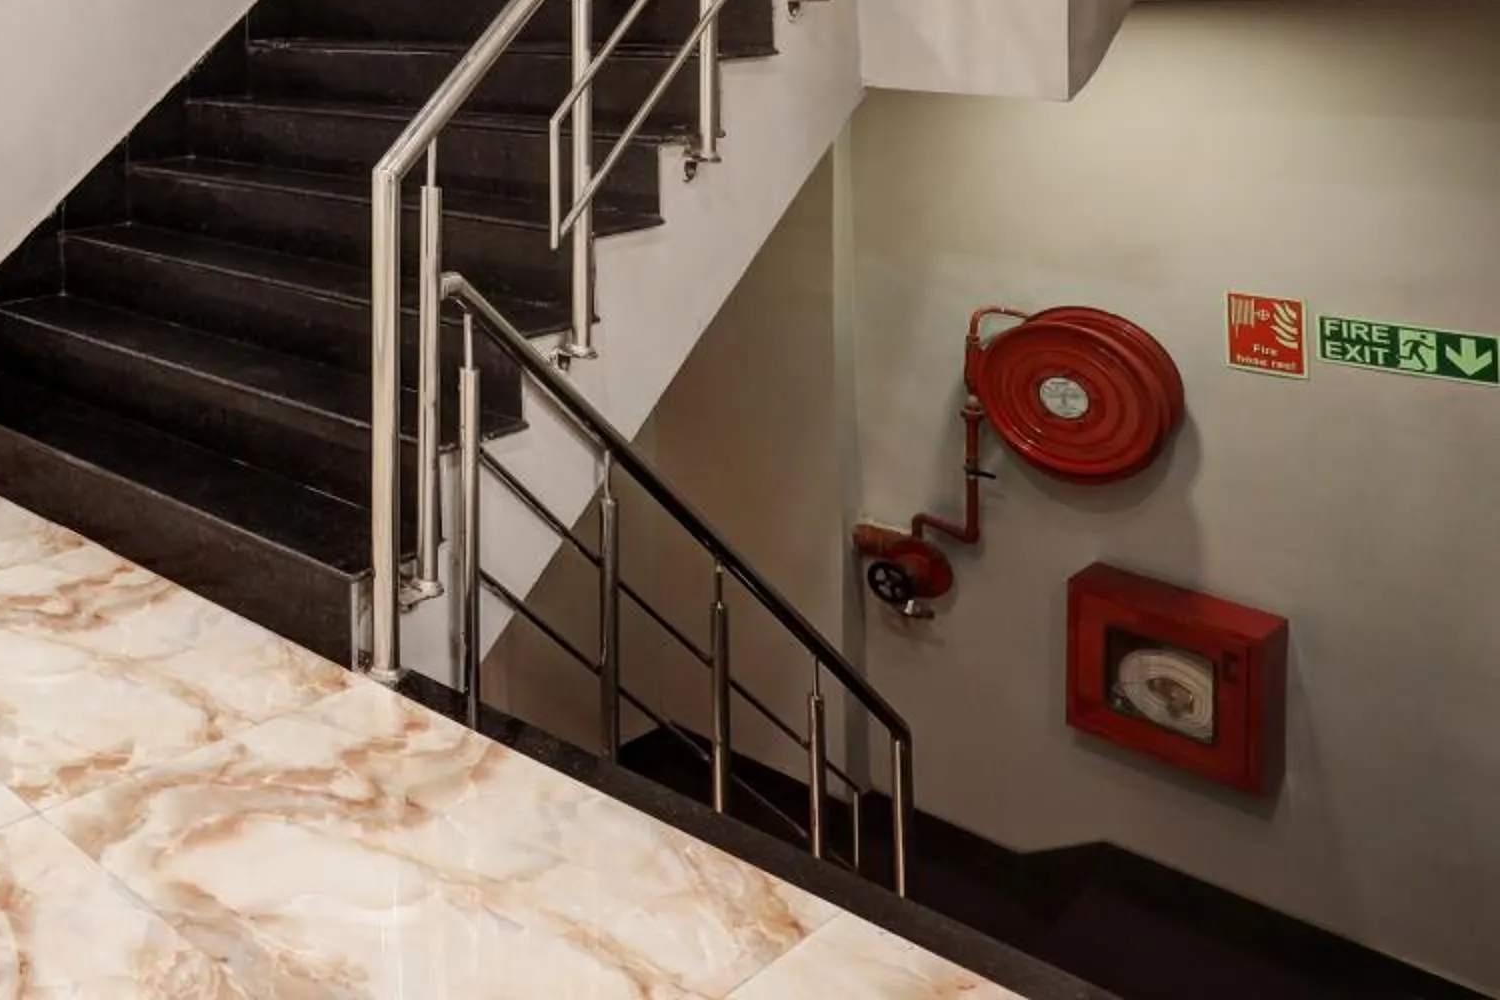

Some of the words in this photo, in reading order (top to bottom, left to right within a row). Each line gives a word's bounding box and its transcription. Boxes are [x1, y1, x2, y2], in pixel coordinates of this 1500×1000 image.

[1324, 319, 1390, 344] FIRE
[1253, 343, 1278, 356] Fire
[1325, 340, 1390, 365] EXIT
